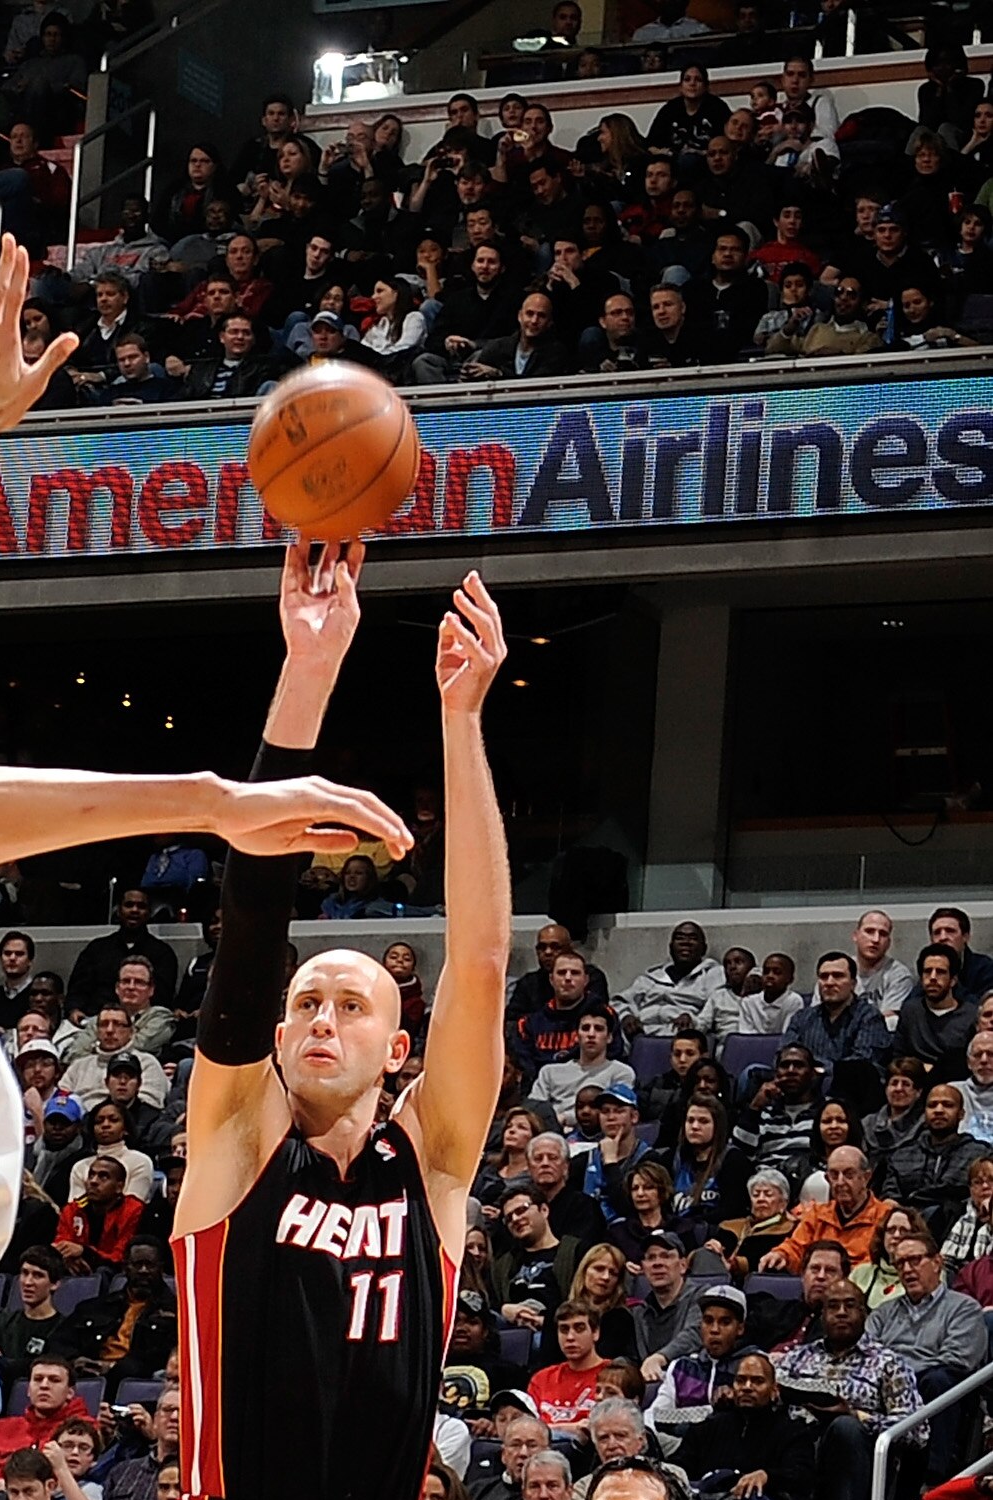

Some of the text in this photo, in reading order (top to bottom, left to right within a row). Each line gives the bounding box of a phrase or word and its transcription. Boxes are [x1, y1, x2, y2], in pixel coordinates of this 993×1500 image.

[518, 400, 993, 526] Airlines
[275, 1188, 408, 1259] HEAT
[347, 1270, 404, 1342] 11
